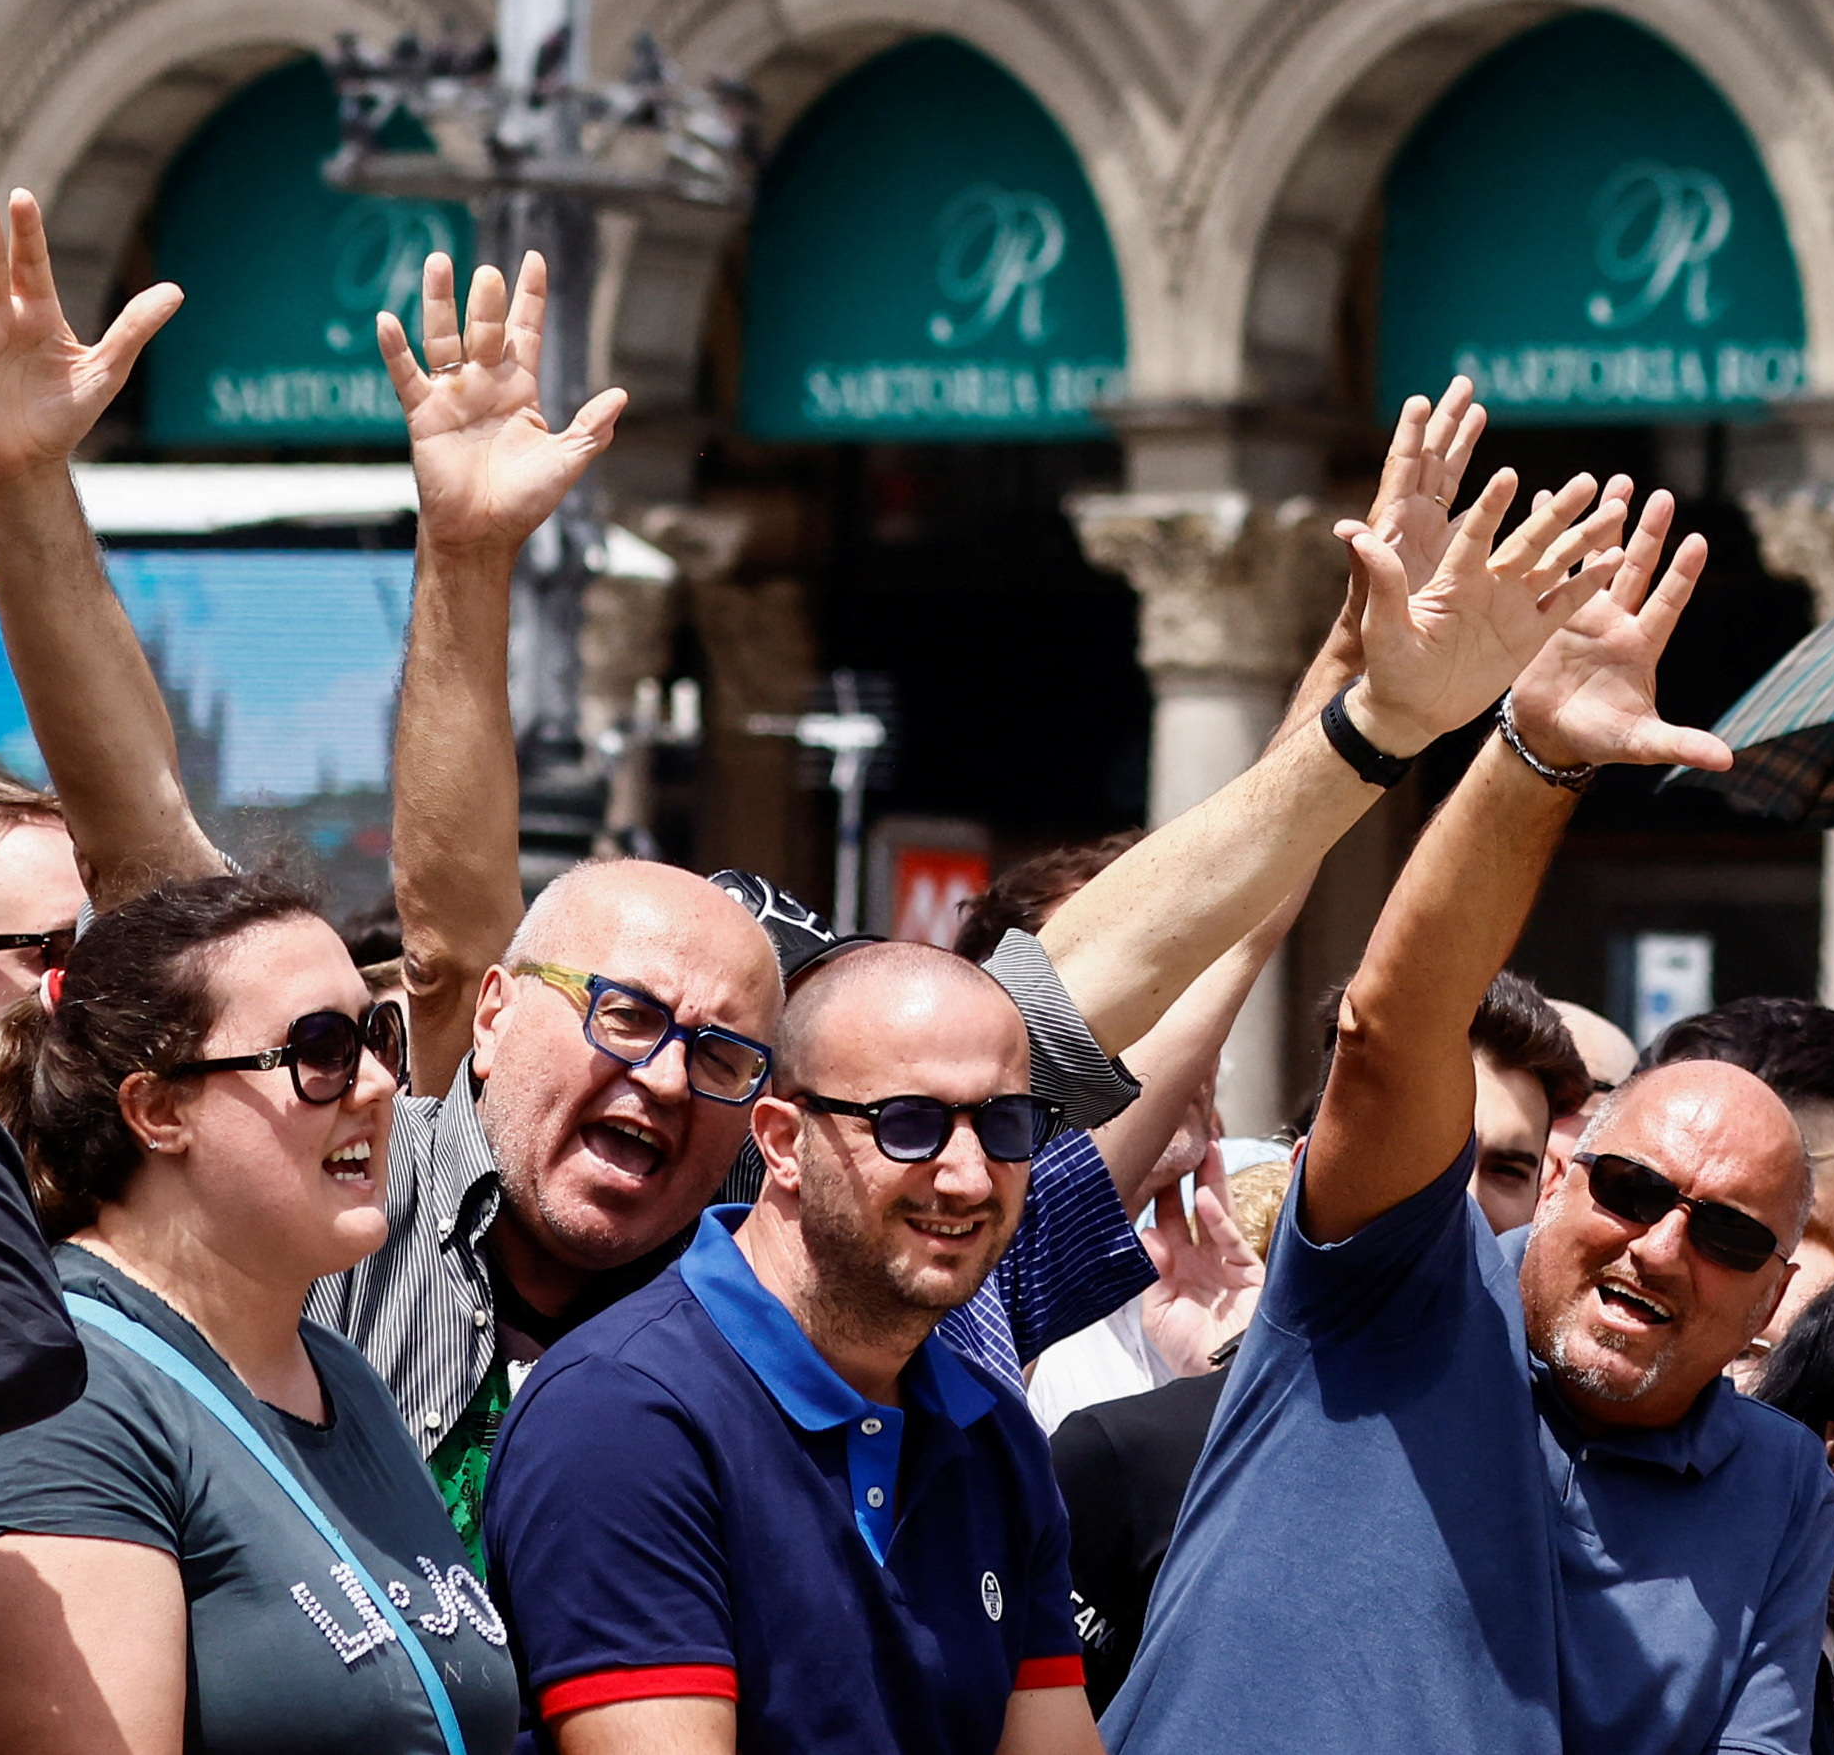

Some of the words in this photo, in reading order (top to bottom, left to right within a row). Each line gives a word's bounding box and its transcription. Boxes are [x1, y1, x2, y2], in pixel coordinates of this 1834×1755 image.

[210, 369, 407, 424] SARTORI
[804, 364, 1041, 420] SARTORIA
[1050, 363, 1127, 415] RO
[1454, 347, 1708, 405] SARTORIA
